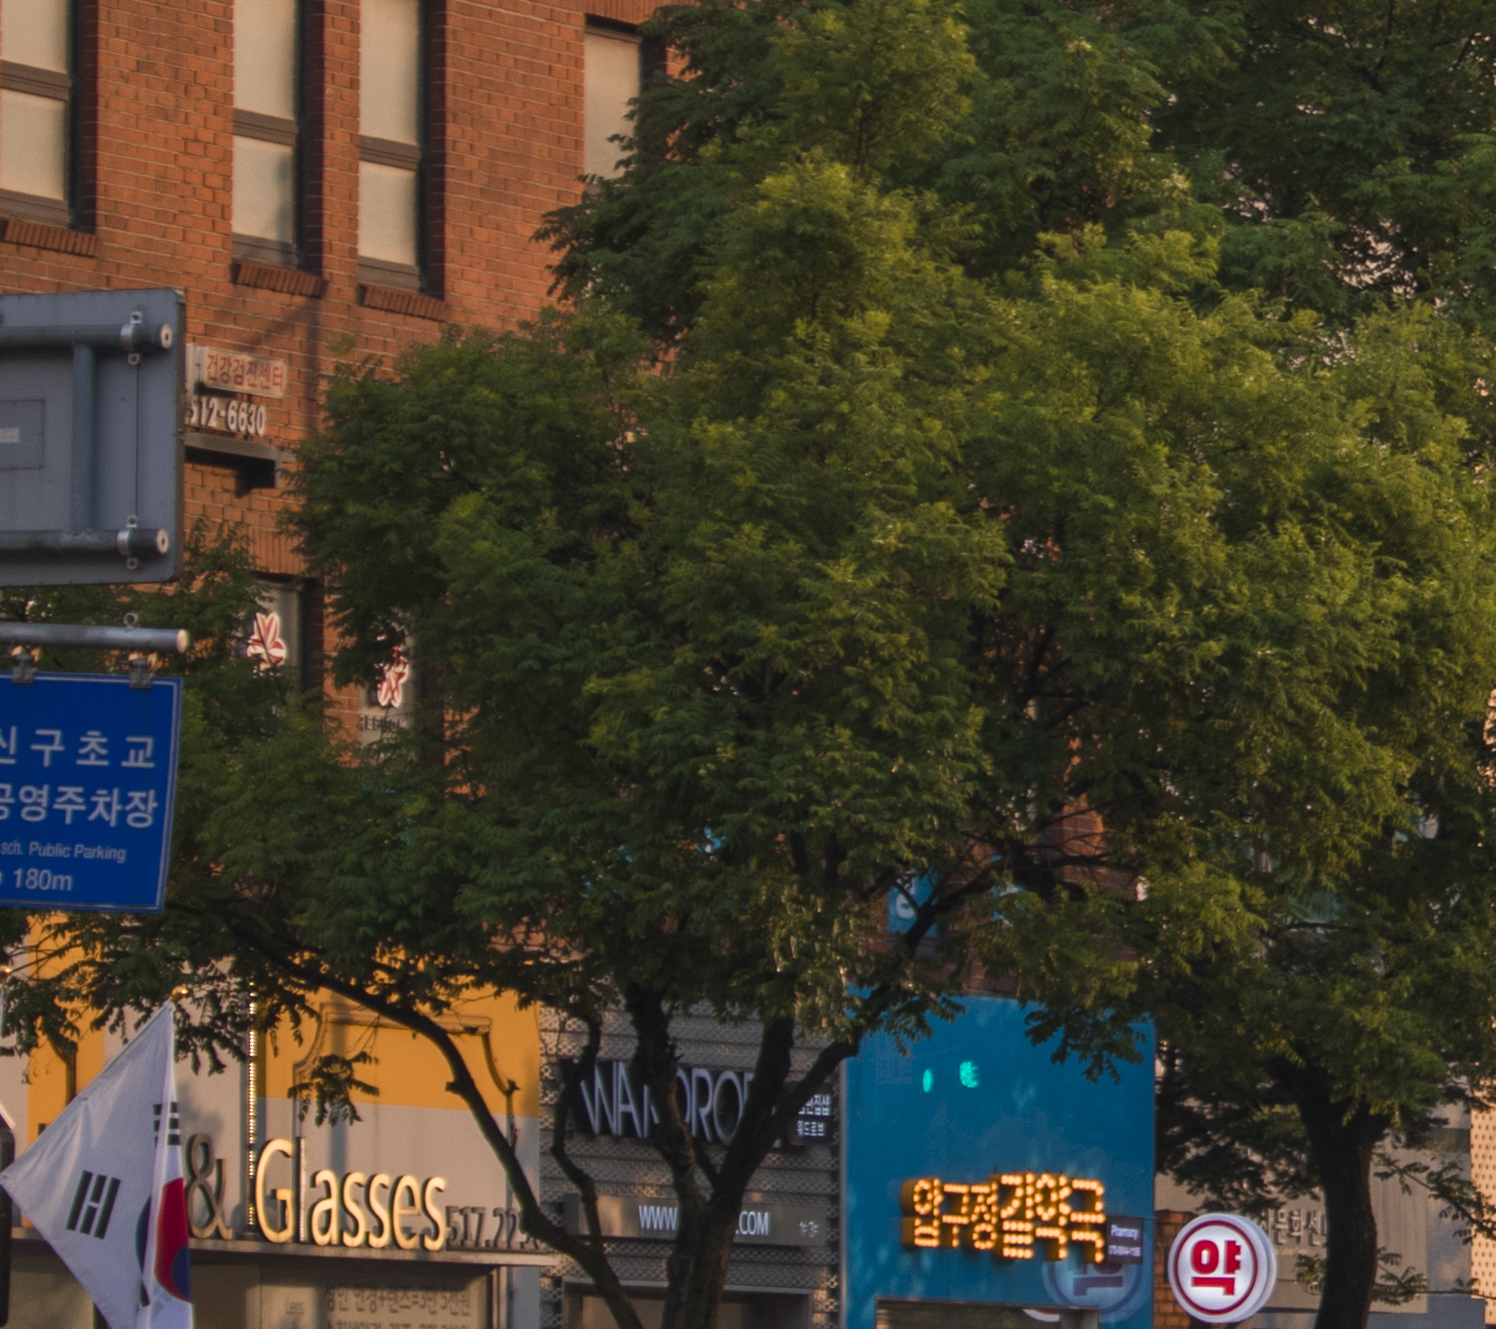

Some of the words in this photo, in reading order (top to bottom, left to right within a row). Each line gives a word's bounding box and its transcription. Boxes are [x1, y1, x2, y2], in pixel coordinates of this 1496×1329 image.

[1, 838, 24, 856] sch.
[28, 841, 71, 859] Public
[73, 843, 128, 865] Parking
[12, 867, 74, 891] 180m
[254, 1136, 448, 1252] Glasses
[1190, 1239, 1242, 1297] 약
